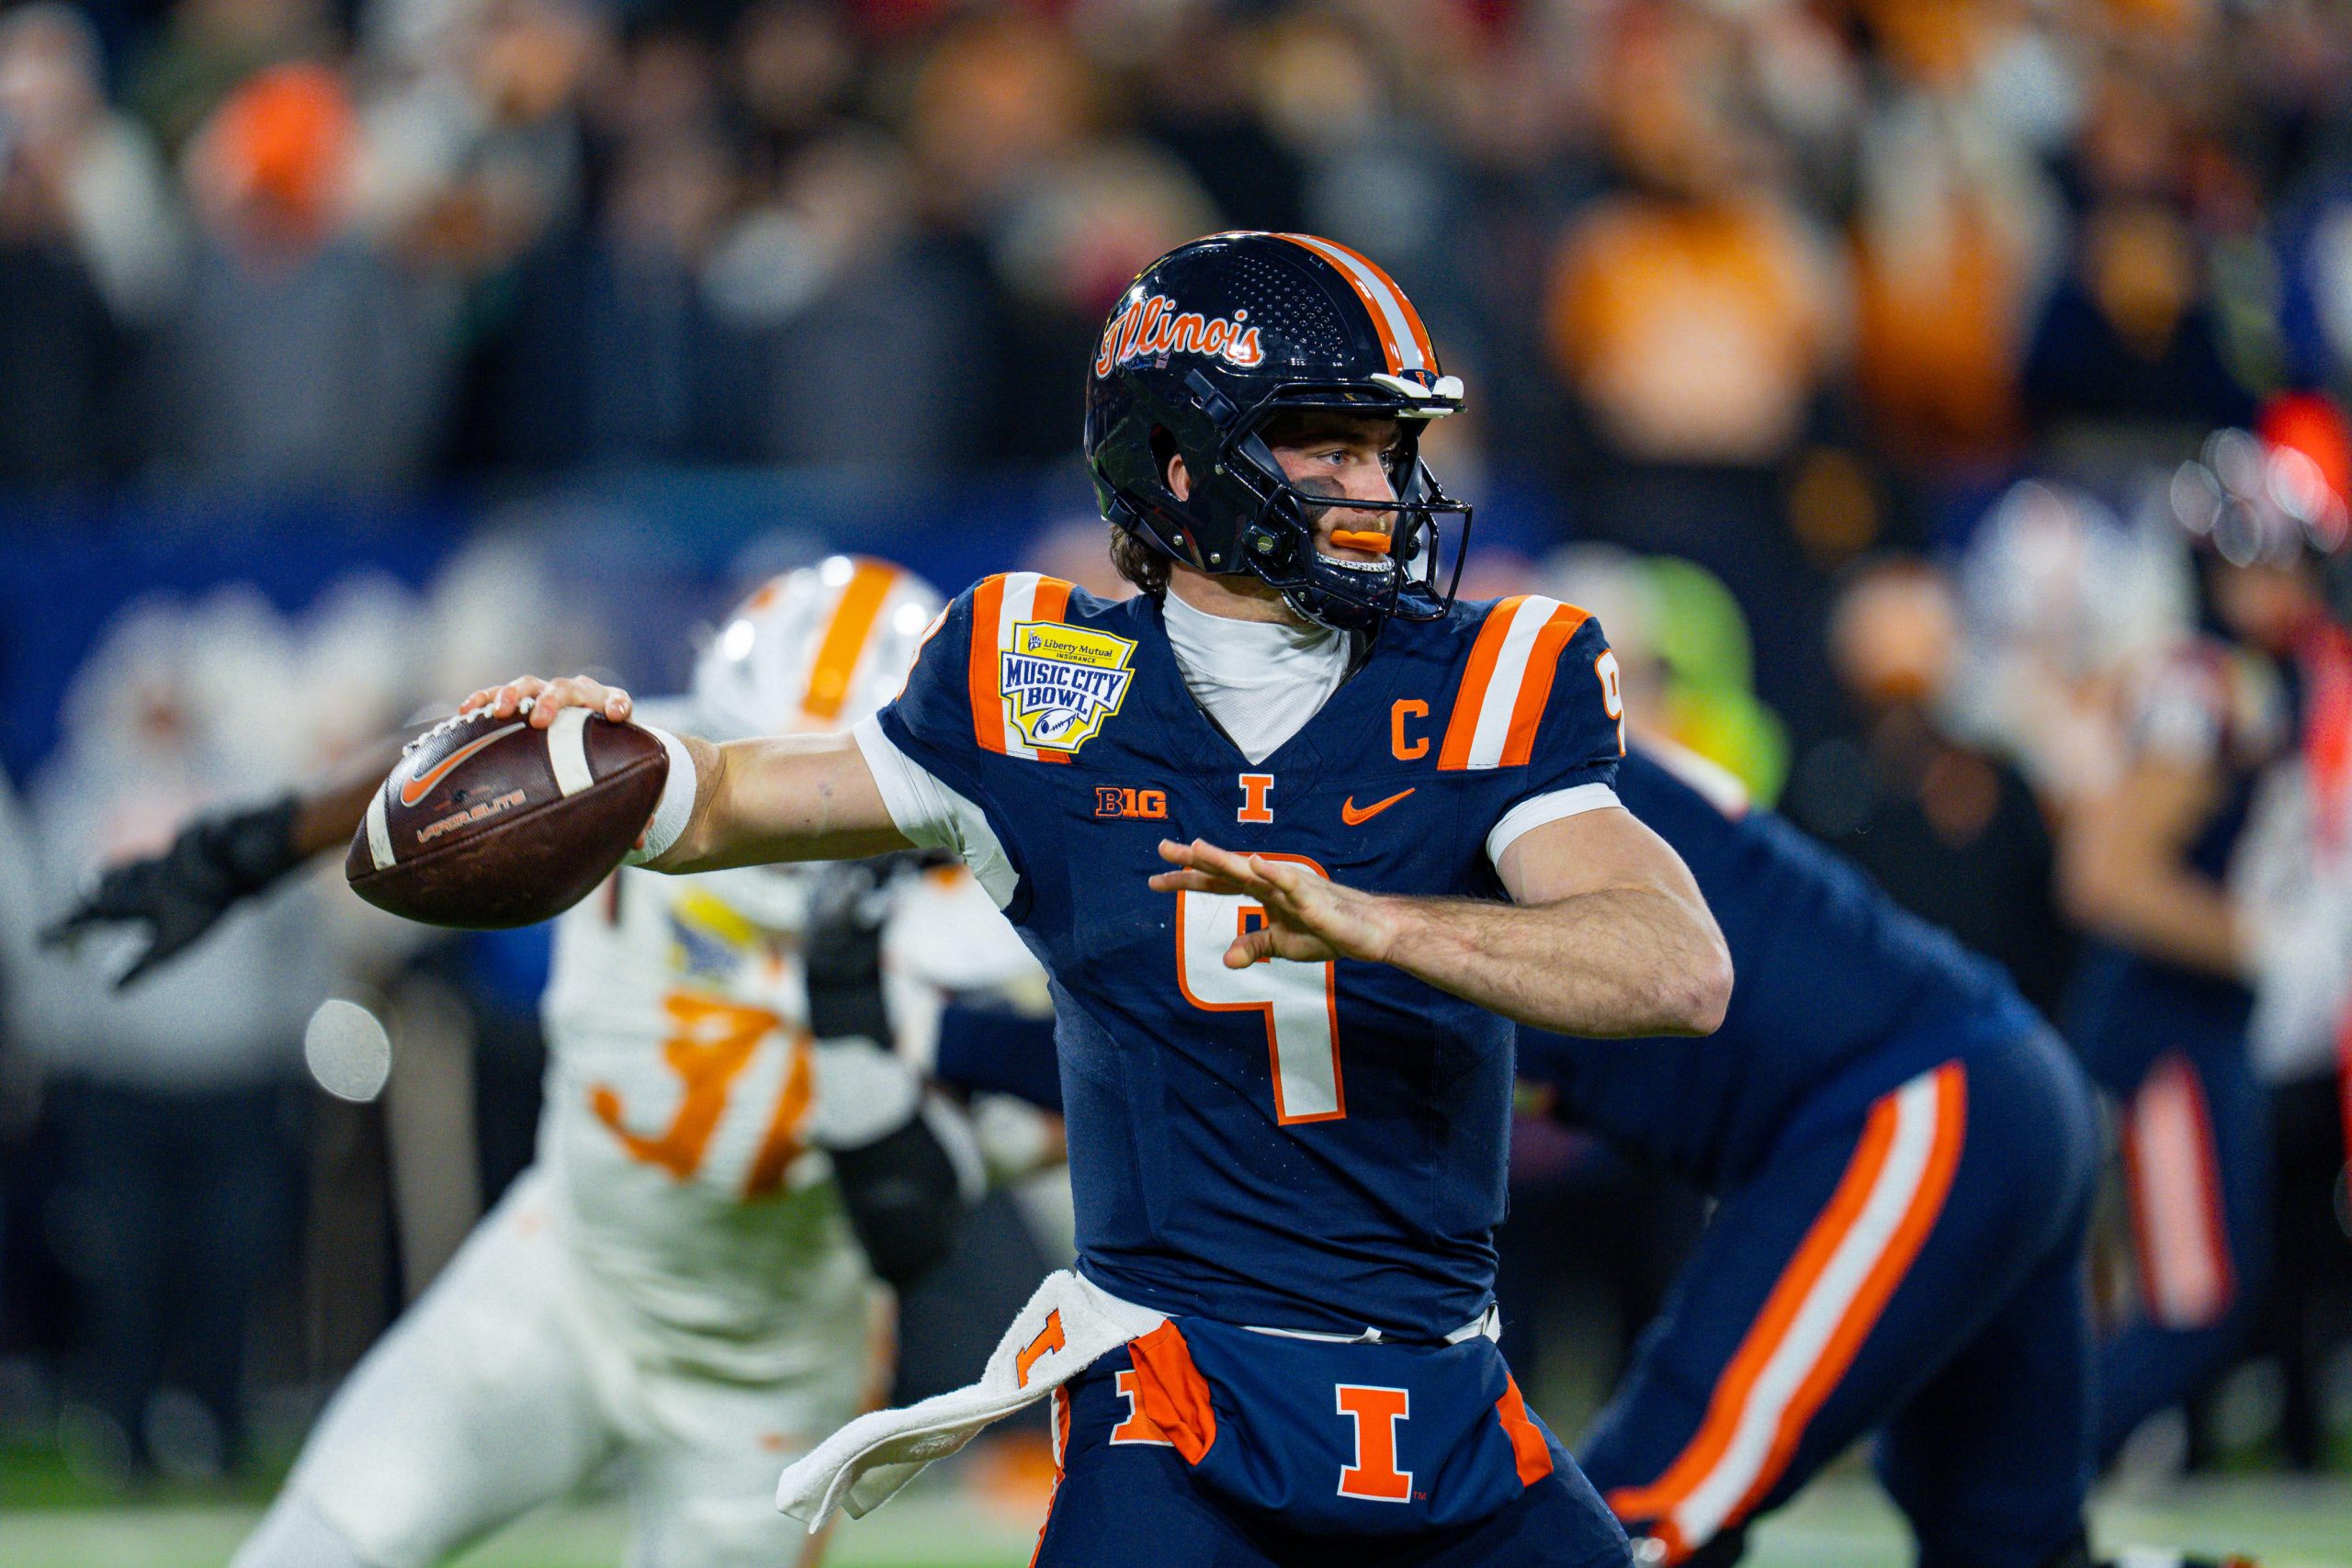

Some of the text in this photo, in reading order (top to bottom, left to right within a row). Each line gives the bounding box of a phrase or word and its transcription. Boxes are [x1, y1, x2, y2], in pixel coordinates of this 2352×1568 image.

[1096, 295, 1263, 378] Illinois
[1044, 638, 1113, 658] Liberty Mutual
[1057, 652, 1096, 663] INSURANCE
[1005, 657, 1124, 703] MUSIC CITY
[1026, 686, 1088, 716] BOWL
[1391, 698, 1429, 761] C
[470, 788, 526, 819] ELITE
[1238, 773, 1273, 823] I
[1175, 851, 1347, 1126] 9
[1335, 1383, 1427, 1504] I TM
